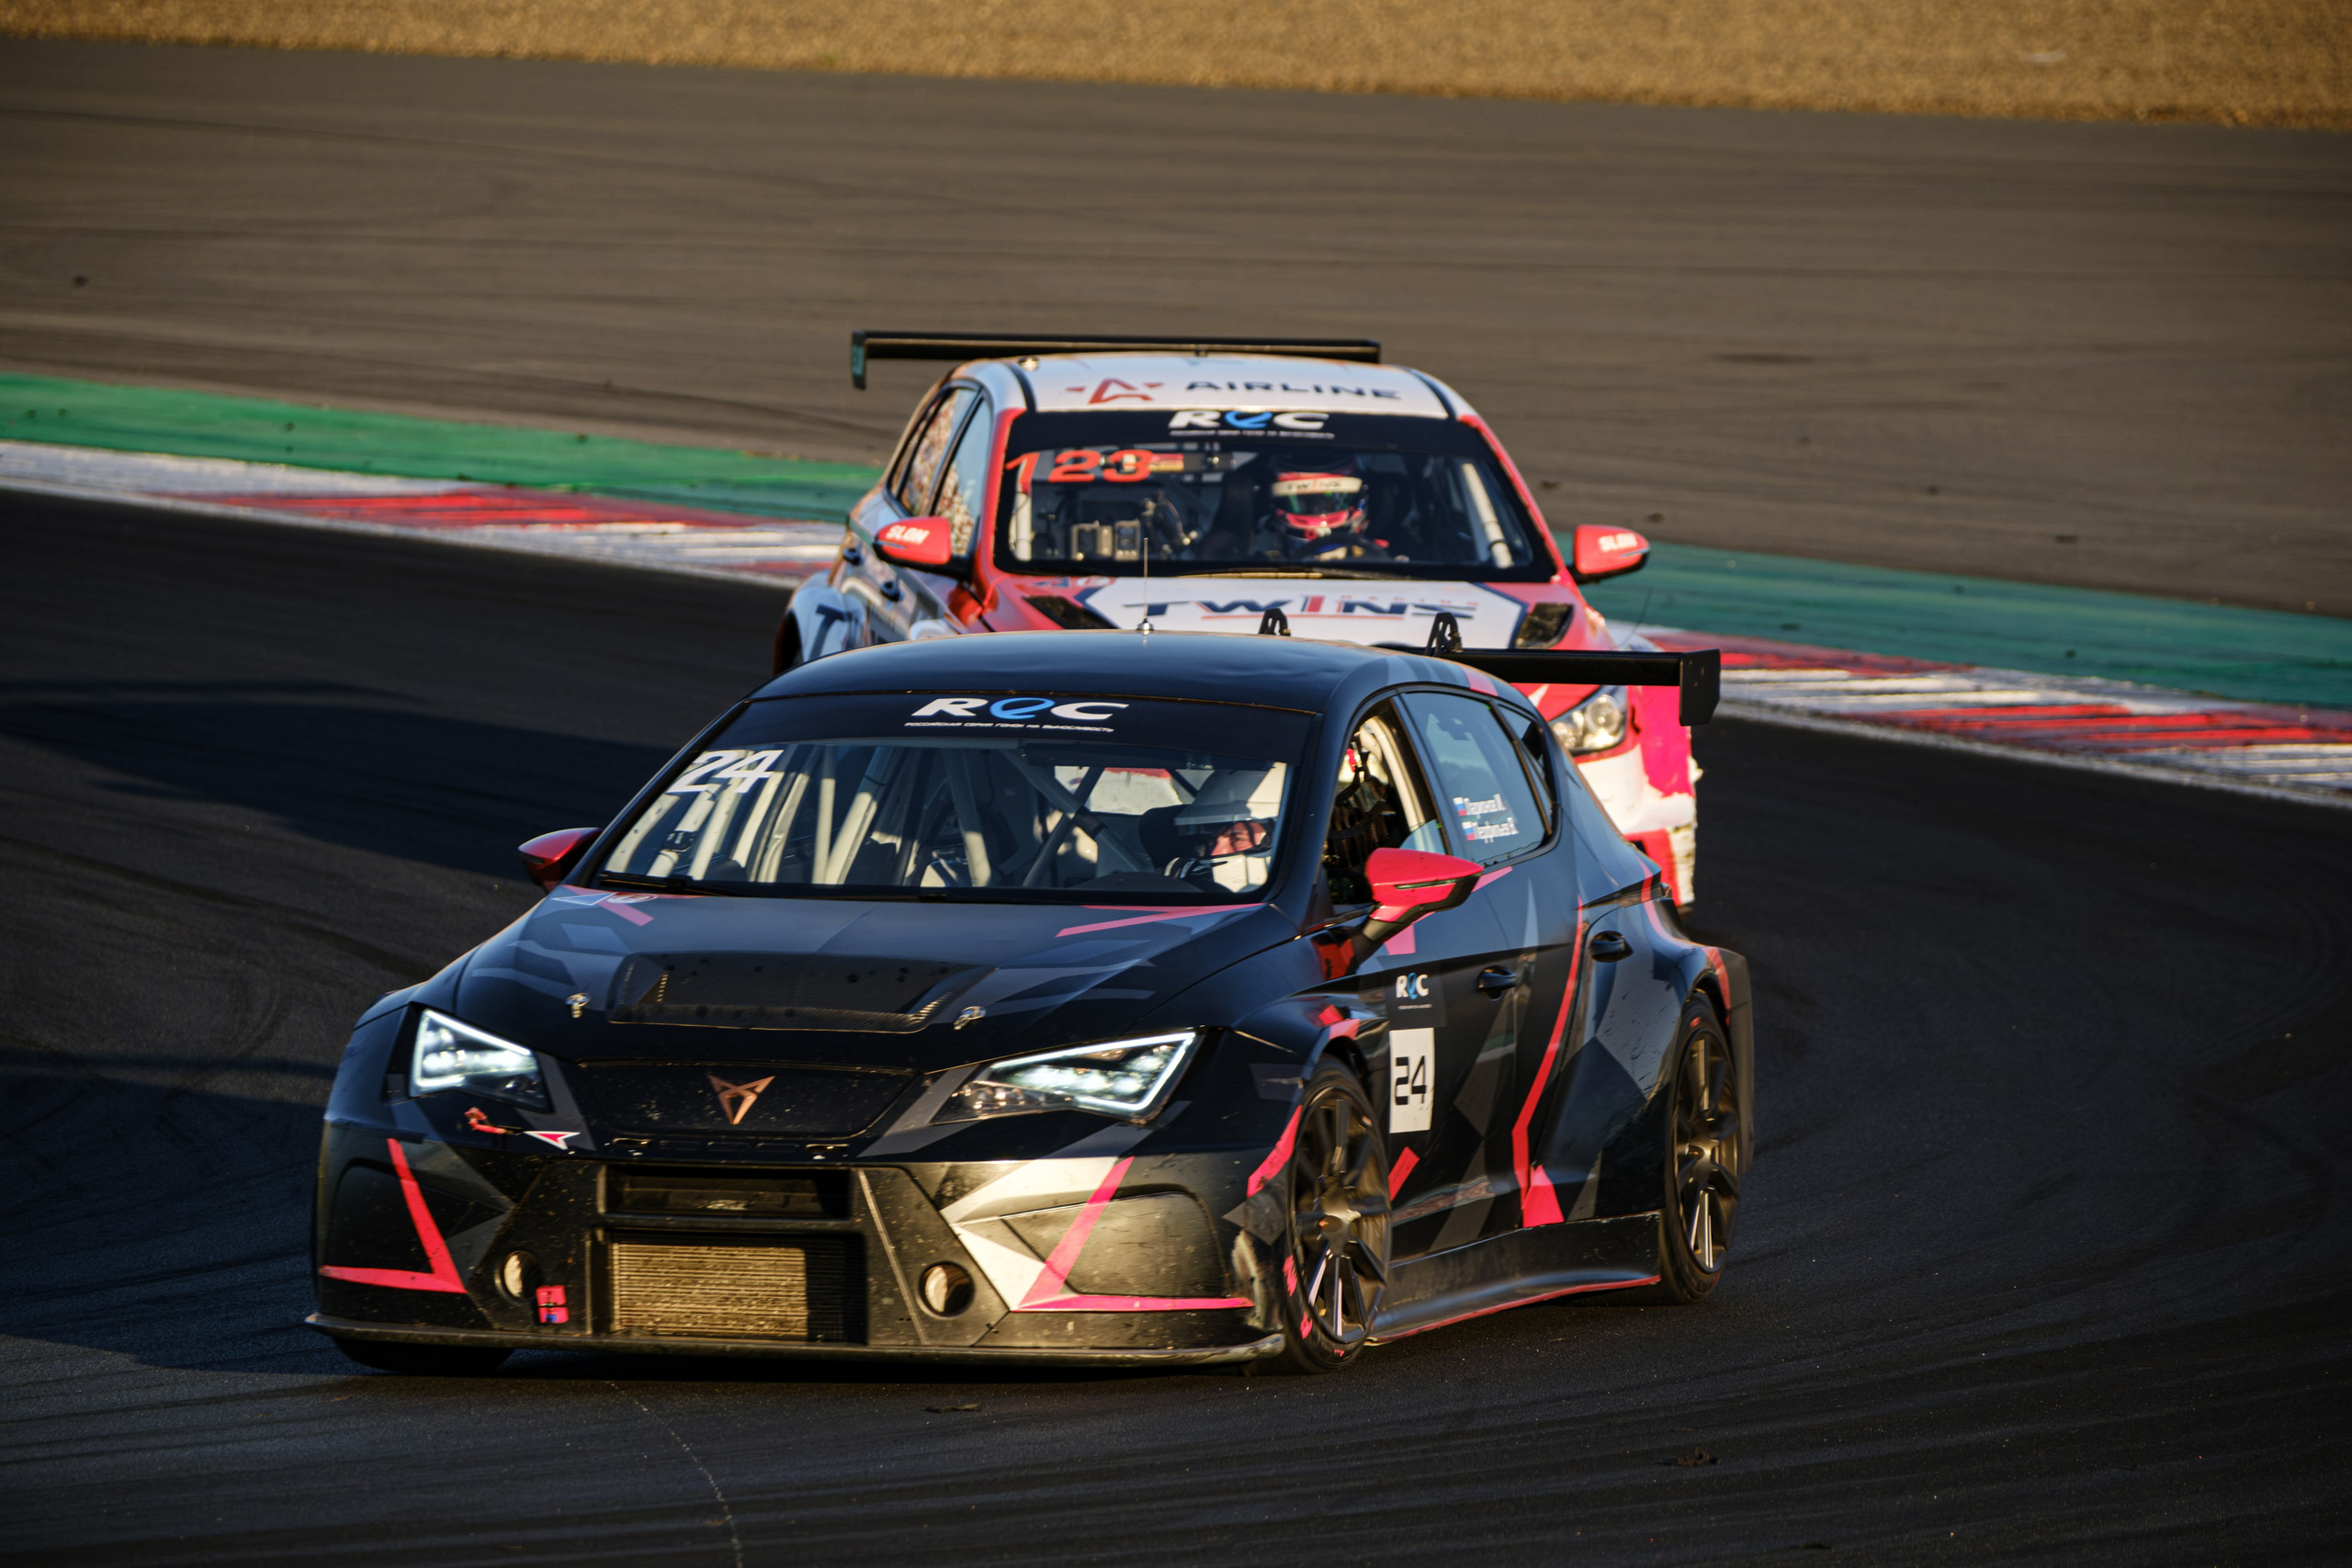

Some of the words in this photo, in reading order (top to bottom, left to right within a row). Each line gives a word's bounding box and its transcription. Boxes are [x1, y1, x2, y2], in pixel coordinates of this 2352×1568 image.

[1185, 380, 1402, 400] AIRLINE
[1005, 448, 1155, 483] 123
[886, 525, 931, 545] SLON
[1122, 594, 1477, 621] TWINS
[665, 750, 785, 794] 24
[1395, 1055, 1427, 1106] 24
